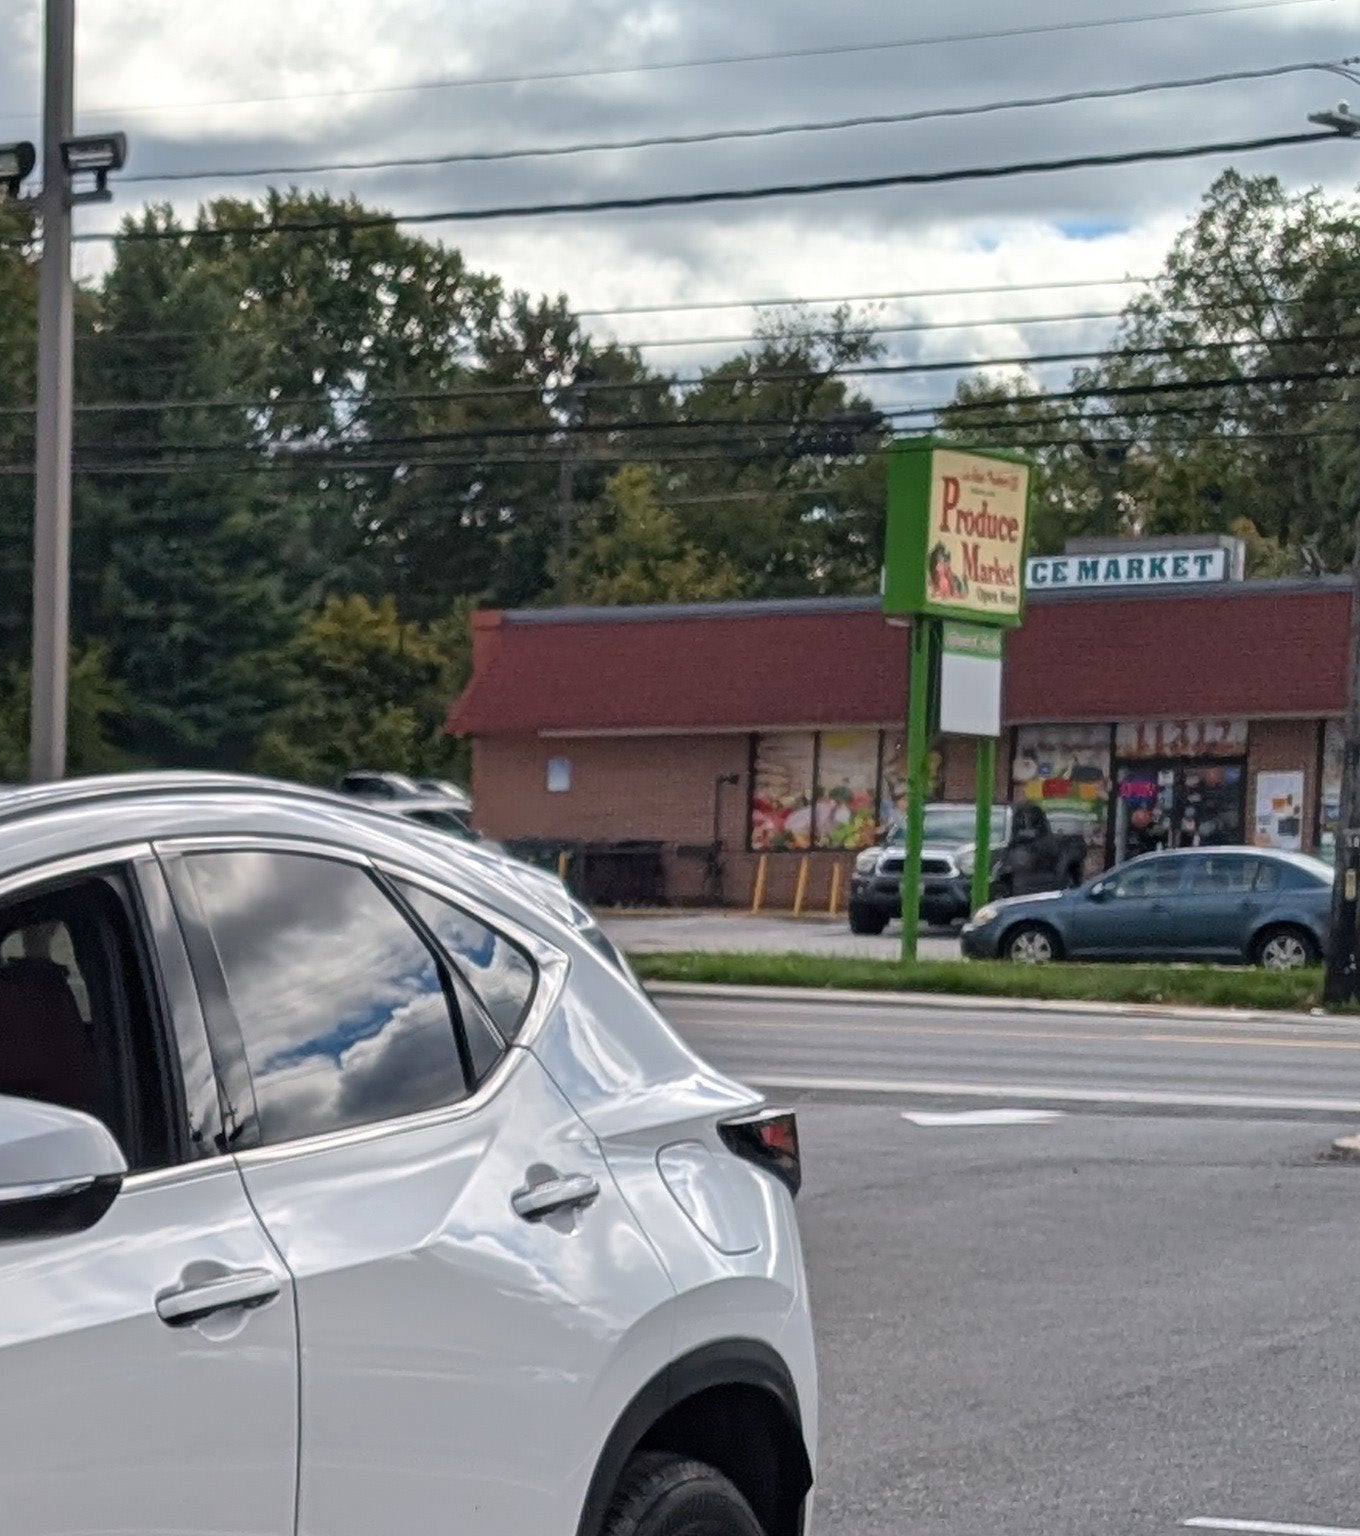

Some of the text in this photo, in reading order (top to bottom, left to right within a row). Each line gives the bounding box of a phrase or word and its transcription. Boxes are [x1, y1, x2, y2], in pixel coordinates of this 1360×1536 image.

[940, 475, 1019, 544] Produce
[961, 541, 1015, 587] Market
[1078, 554, 1213, 582] MARKET
